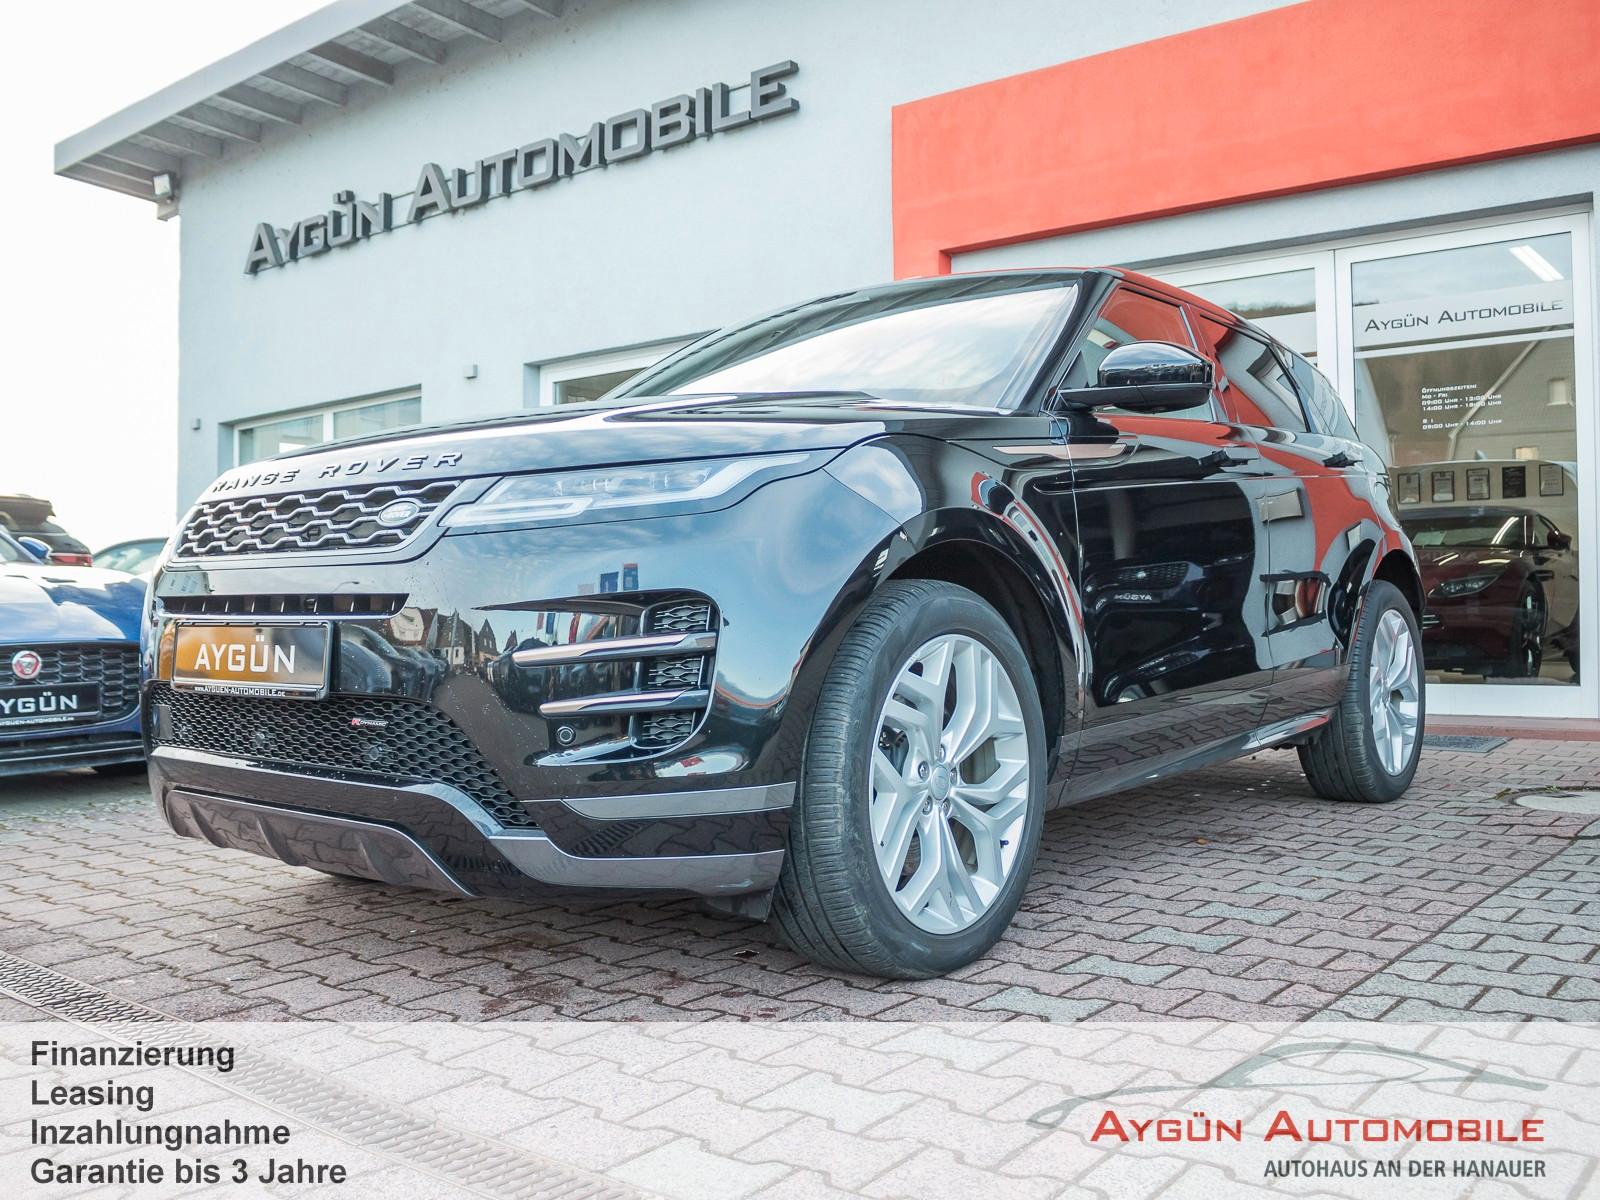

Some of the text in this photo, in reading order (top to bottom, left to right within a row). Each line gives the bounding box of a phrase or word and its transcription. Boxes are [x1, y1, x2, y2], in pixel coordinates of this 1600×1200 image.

[244, 60, 800, 275] AYGÜN AUTOMOBILE
[1365, 300, 1563, 332] AYGÜN AUTOMOBILE
[212, 451, 463, 493] RANGE ROVER
[194, 635, 296, 674] AYGÜN
[0, 691, 78, 714] YGÜN
